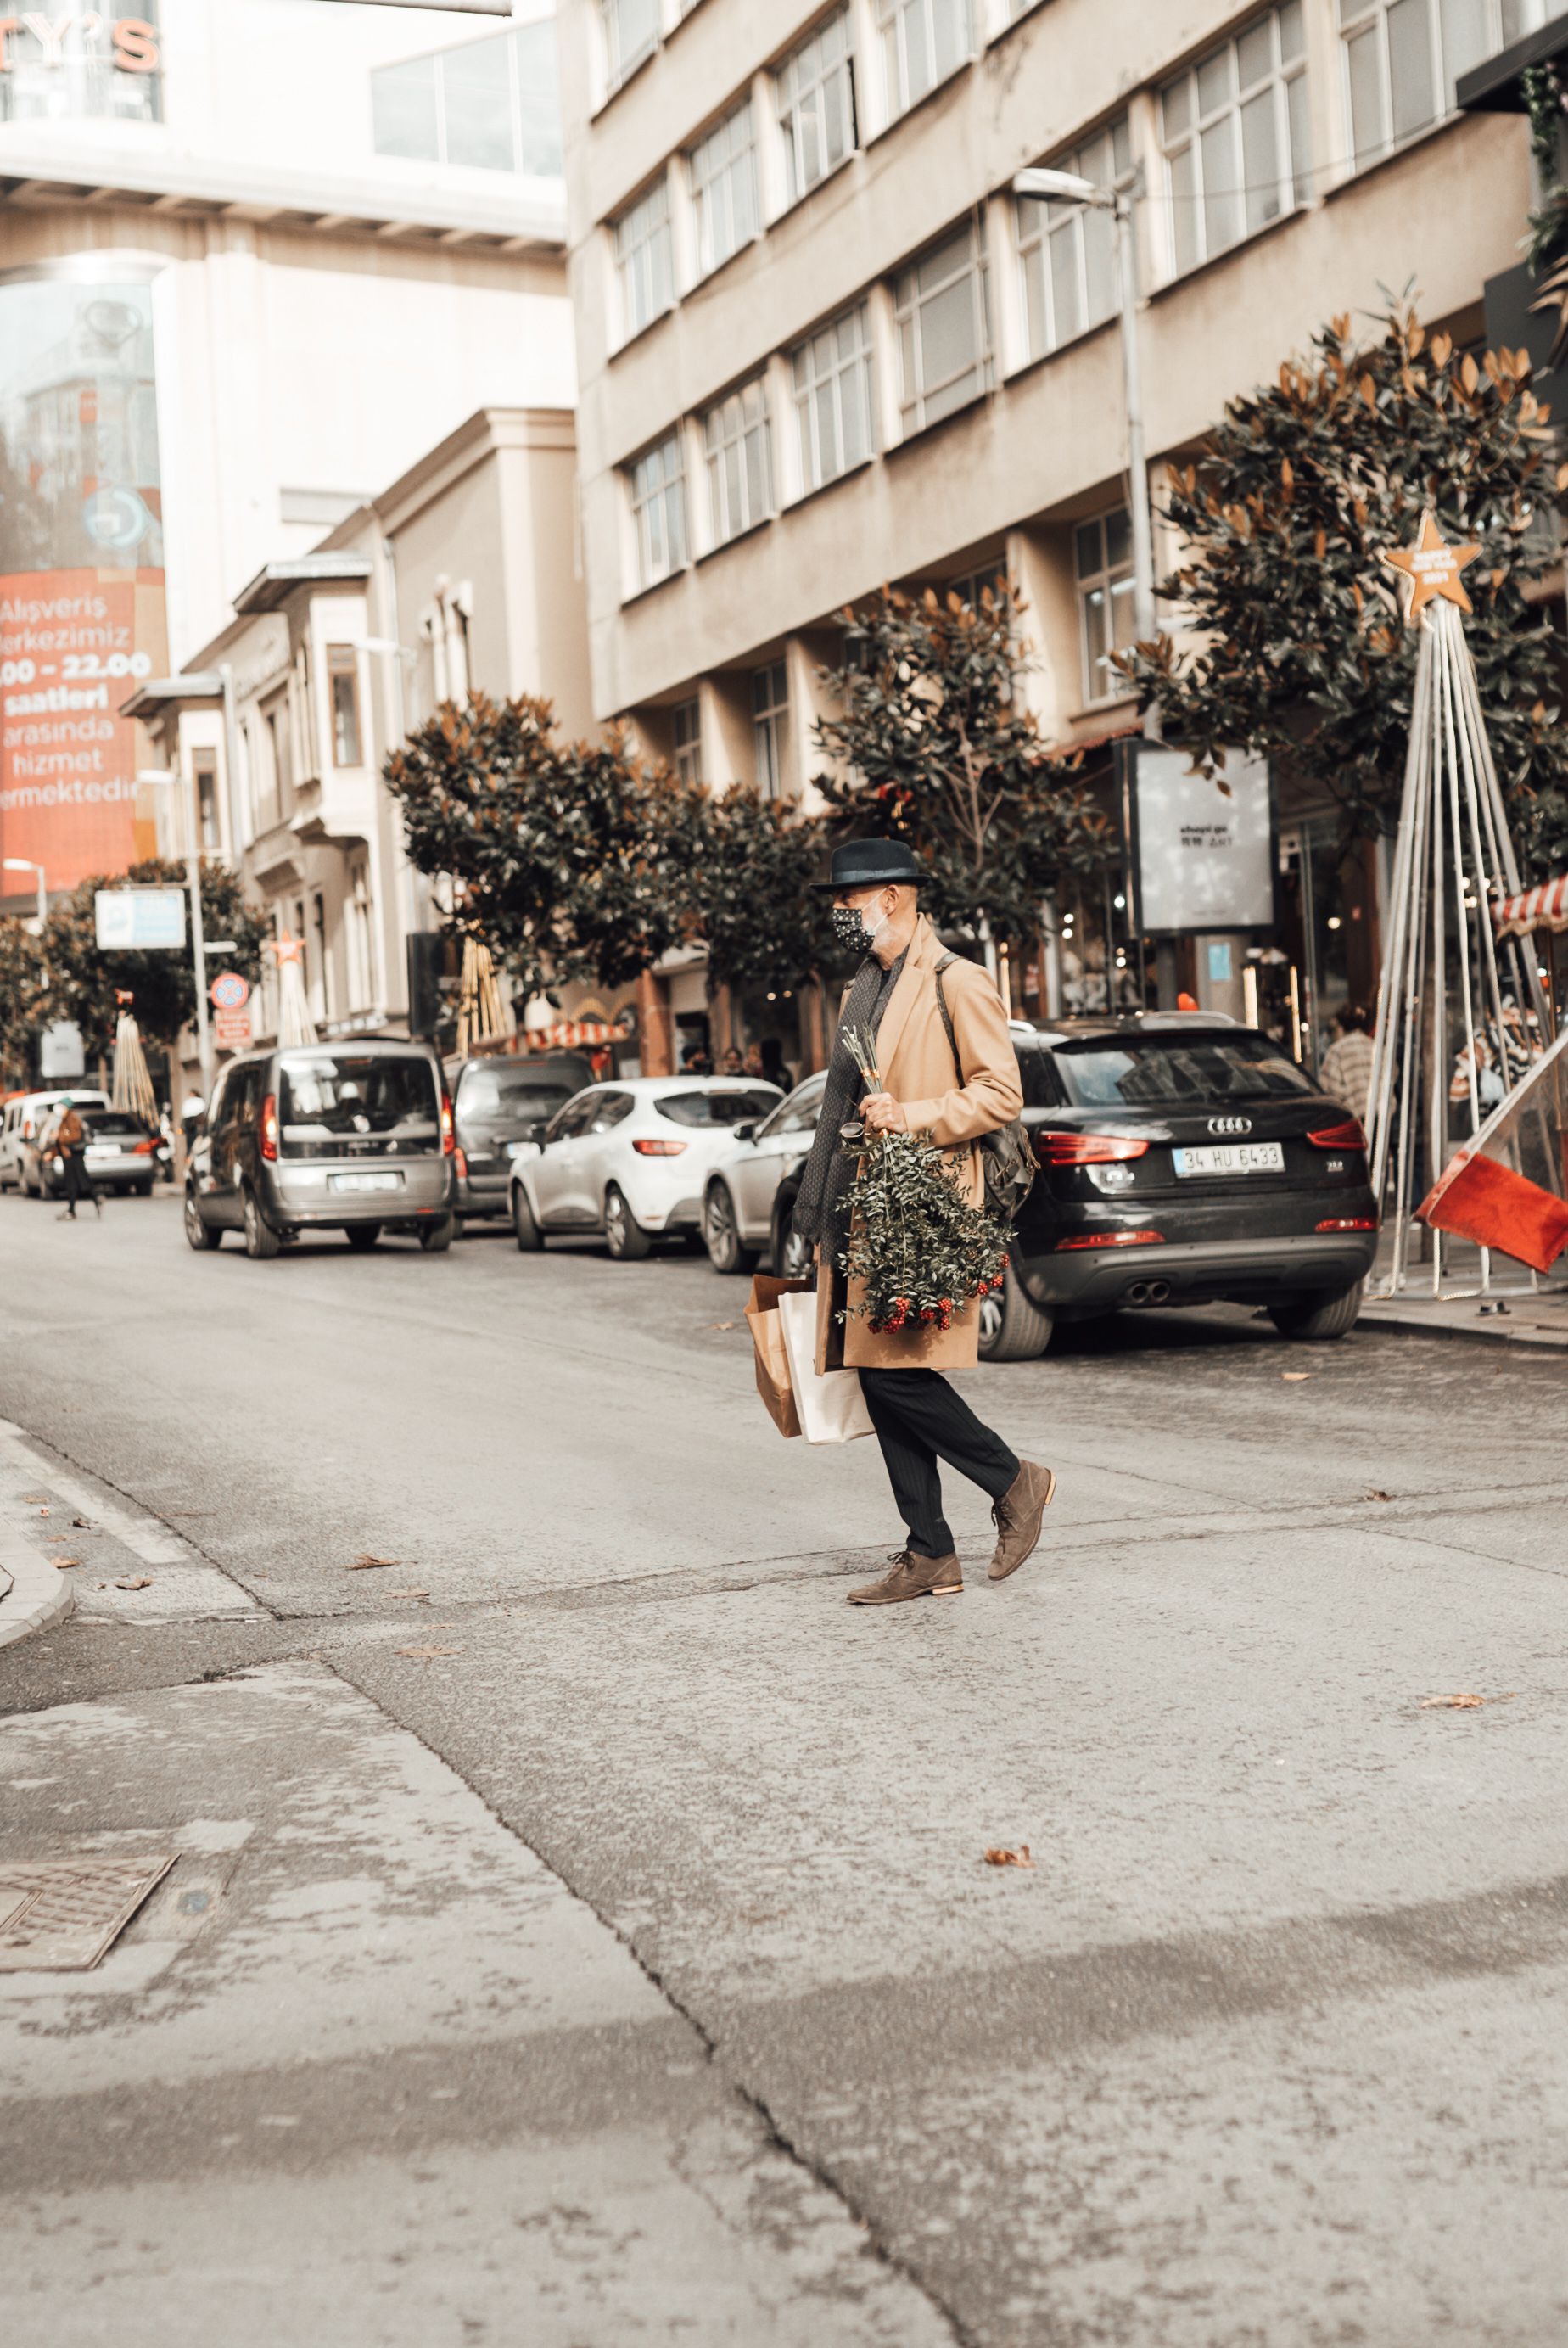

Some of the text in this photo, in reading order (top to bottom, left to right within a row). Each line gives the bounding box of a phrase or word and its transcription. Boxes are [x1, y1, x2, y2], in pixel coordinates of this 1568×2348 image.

[0, 622, 130, 656] erkezimiz
[61, 652, 152, 680] 22.00
[13, 746, 104, 778] hizmet
[1185, 1146, 1278, 1168] 34 HU 6433
